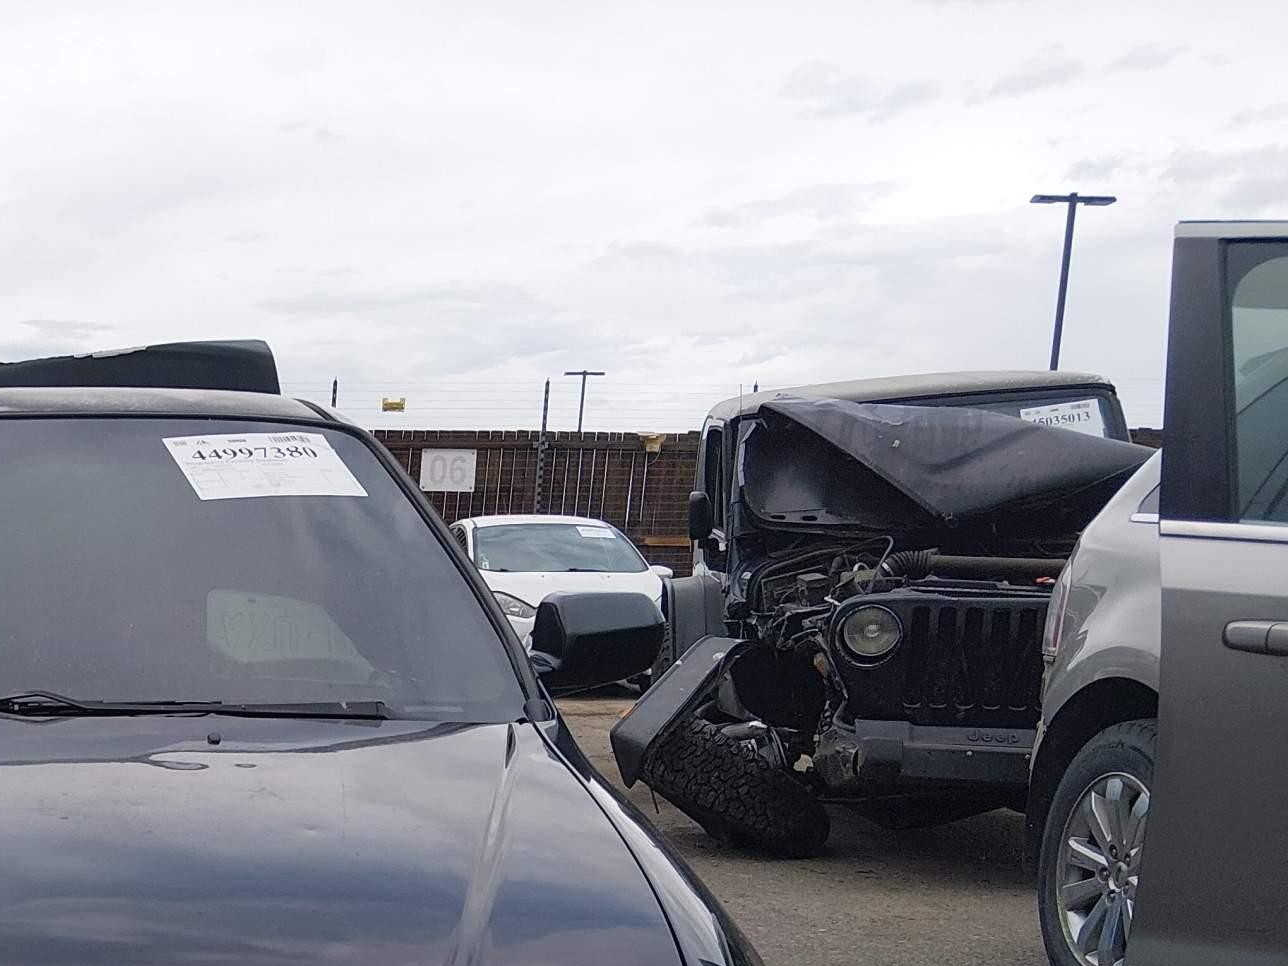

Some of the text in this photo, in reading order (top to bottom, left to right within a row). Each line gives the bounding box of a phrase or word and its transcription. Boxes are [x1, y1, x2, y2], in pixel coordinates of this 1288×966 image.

[191, 446, 319, 461] 44997380
[430, 456, 467, 484] 06
[967, 728, 1018, 745] Jeep
